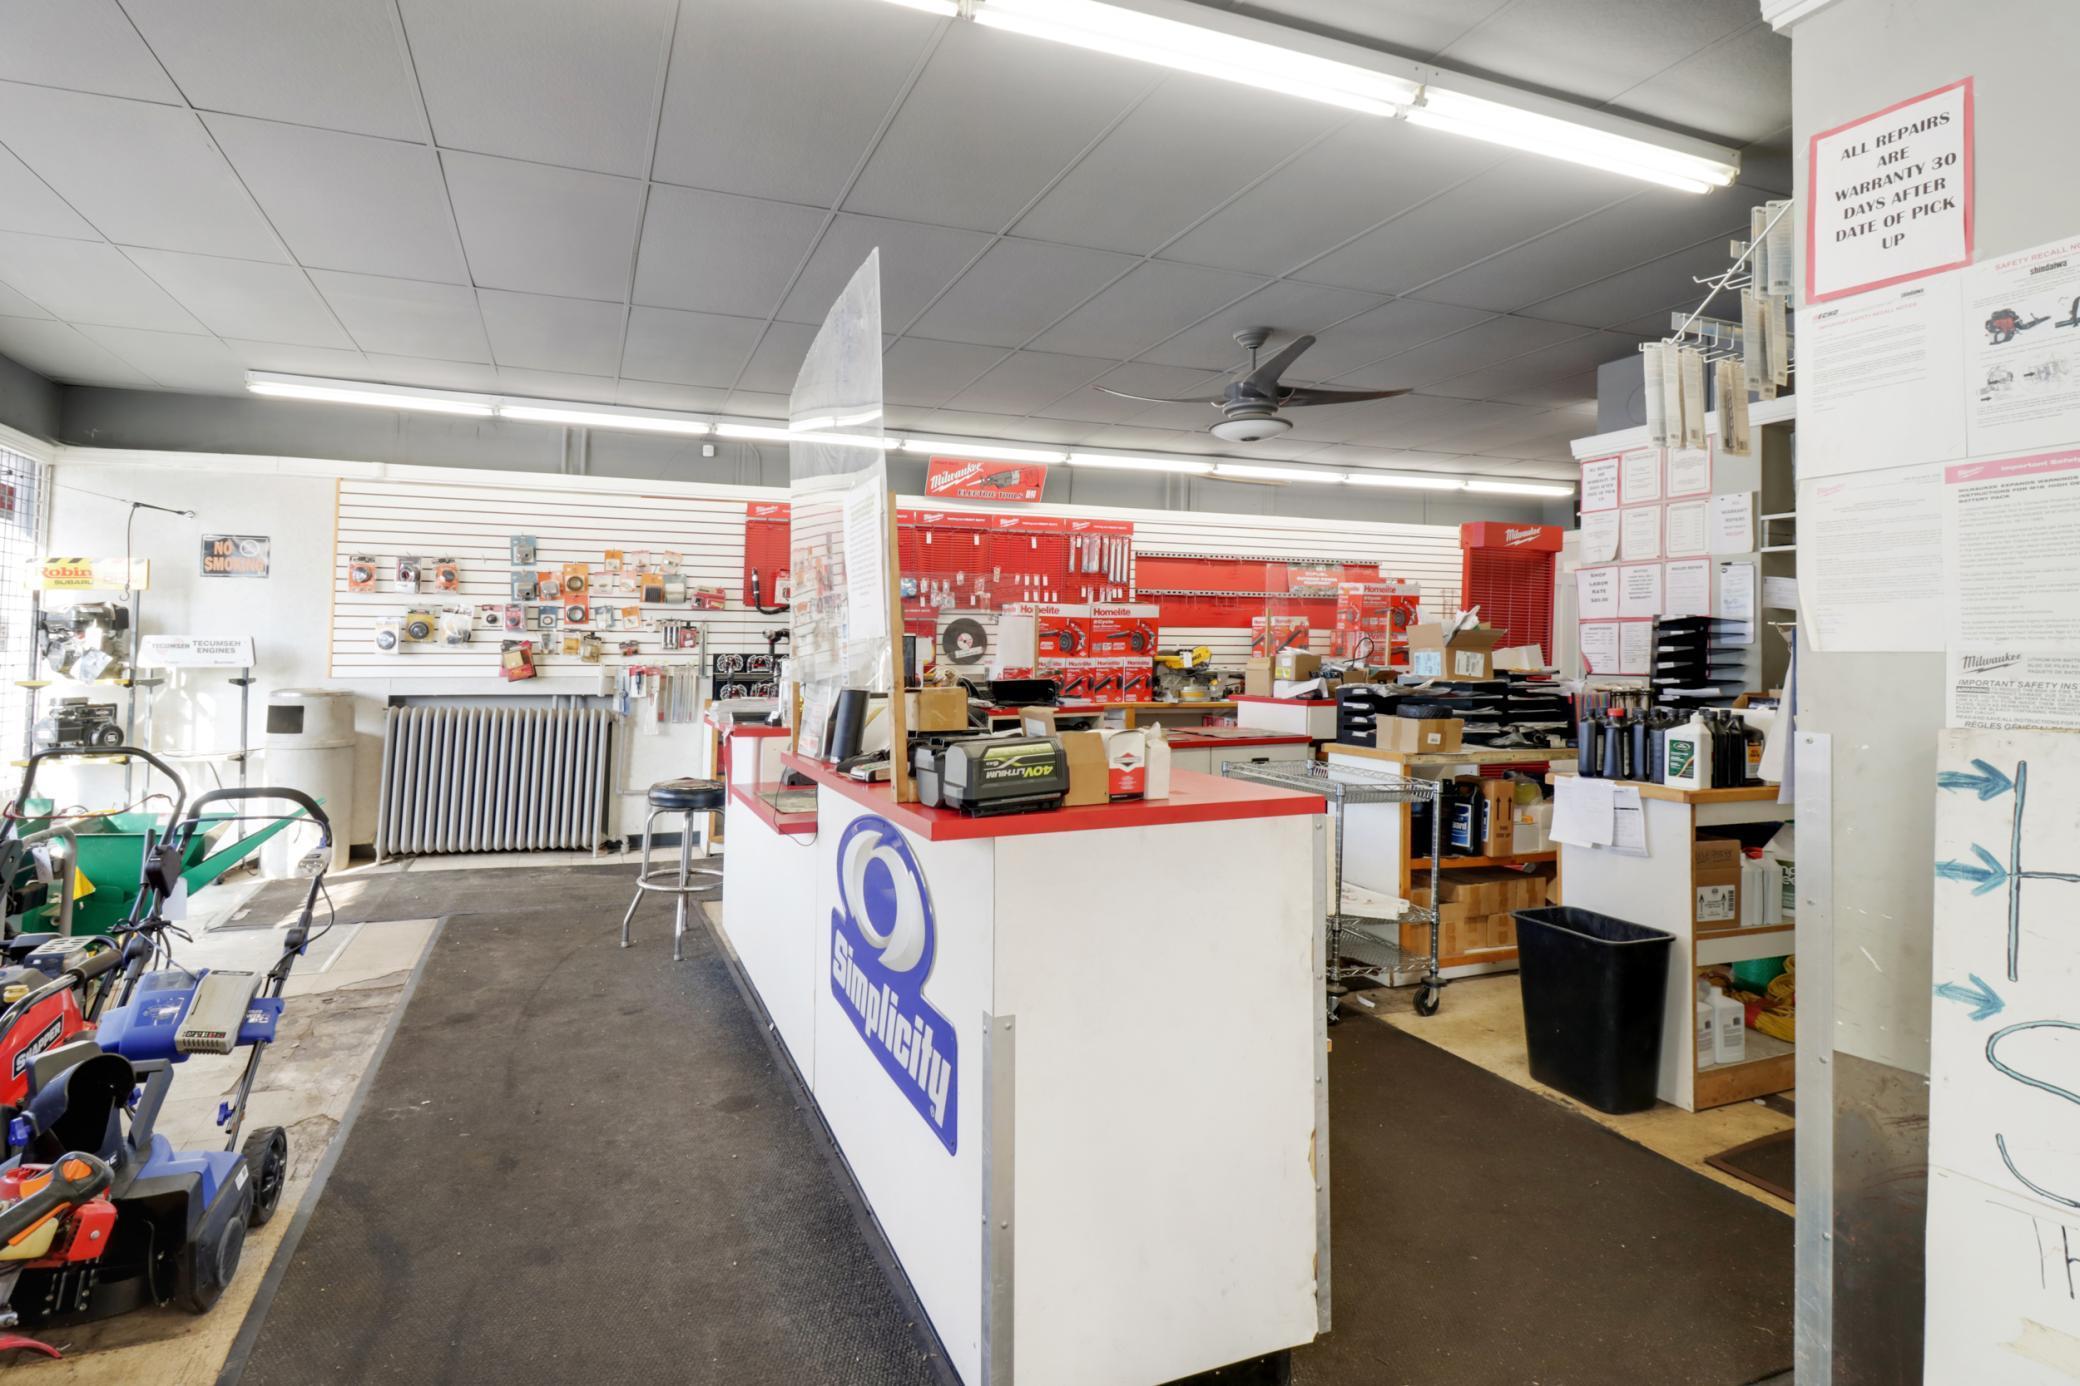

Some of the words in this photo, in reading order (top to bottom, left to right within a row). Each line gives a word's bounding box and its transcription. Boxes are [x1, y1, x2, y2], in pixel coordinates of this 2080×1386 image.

[1840, 142, 1870, 161] ALL
[1876, 112, 1950, 148] REPAIRS
[1877, 146, 1910, 168] ARE
[1834, 162, 1925, 202] WARRANTY
[1931, 152, 1956, 171] 30
[1844, 197, 1886, 220] DAYS
[1891, 177, 1946, 205] AFTER
[1836, 220, 1878, 242] DATE
[1883, 211, 1905, 228] OF
[1912, 196, 1956, 220] PICK
[1881, 232, 1905, 250] UP
[1996, 257, 2028, 272] SAFETY
[2031, 248, 2066, 260] RECALL
[2030, 260, 2068, 275] shindaiwa
[214, 541, 232, 555] NO
[1094, 607, 1131, 616] Homelite
[1962, 653, 2022, 670] Milwaukee
[1958, 680, 2016, 688] IMPORTANT
[2017, 681, 2058, 689] SAFETY
[986, 768, 1026, 779] LITHIUM
[832, 928, 952, 1129] Simplicity
